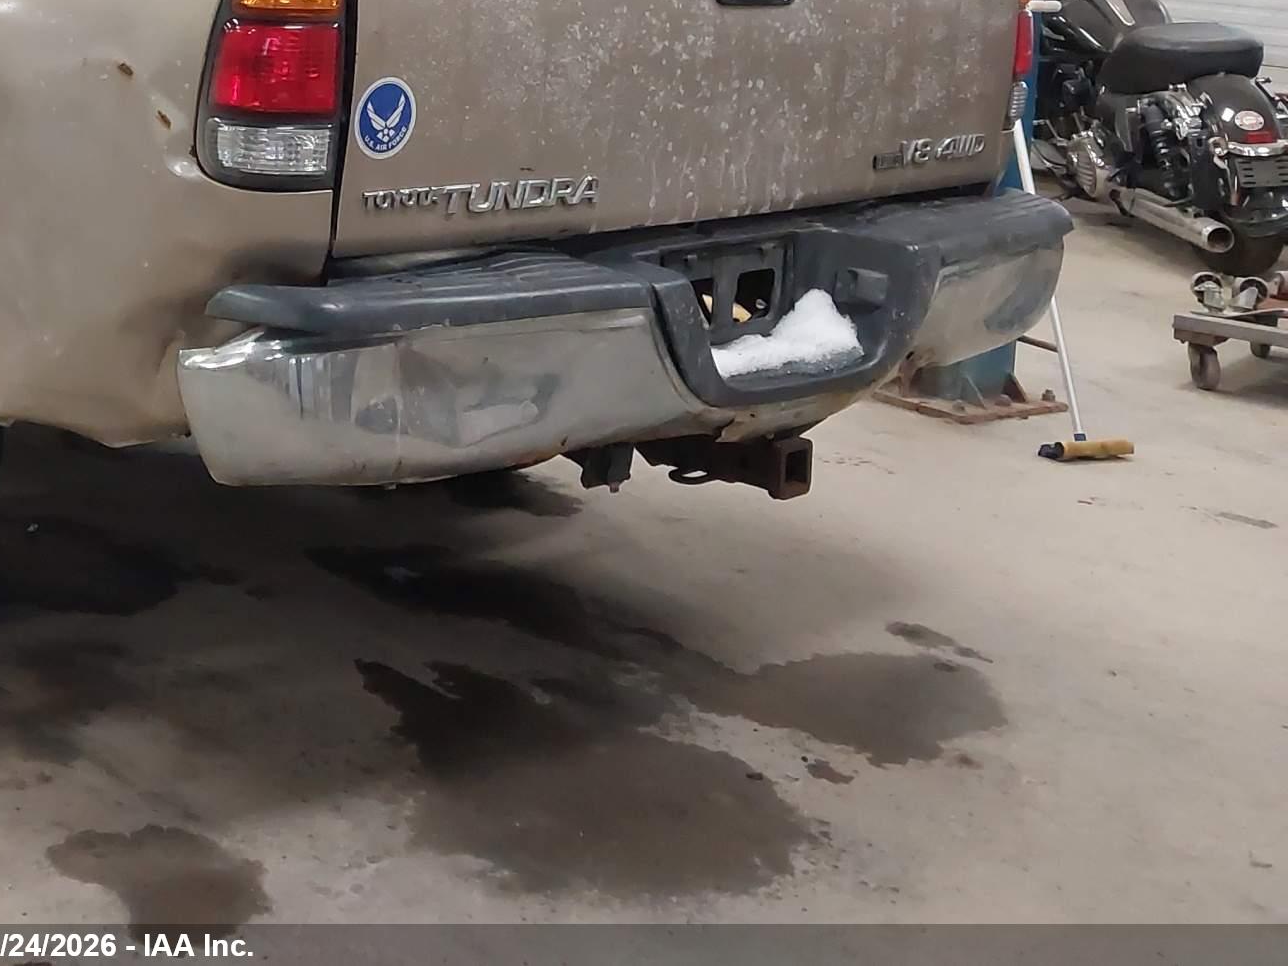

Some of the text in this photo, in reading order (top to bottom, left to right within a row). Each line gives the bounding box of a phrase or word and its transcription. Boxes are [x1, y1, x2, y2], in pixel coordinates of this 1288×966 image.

[375, 143, 388, 151] AIR
[389, 125, 408, 148] FORCE
[444, 175, 600, 214] TUNDRA
